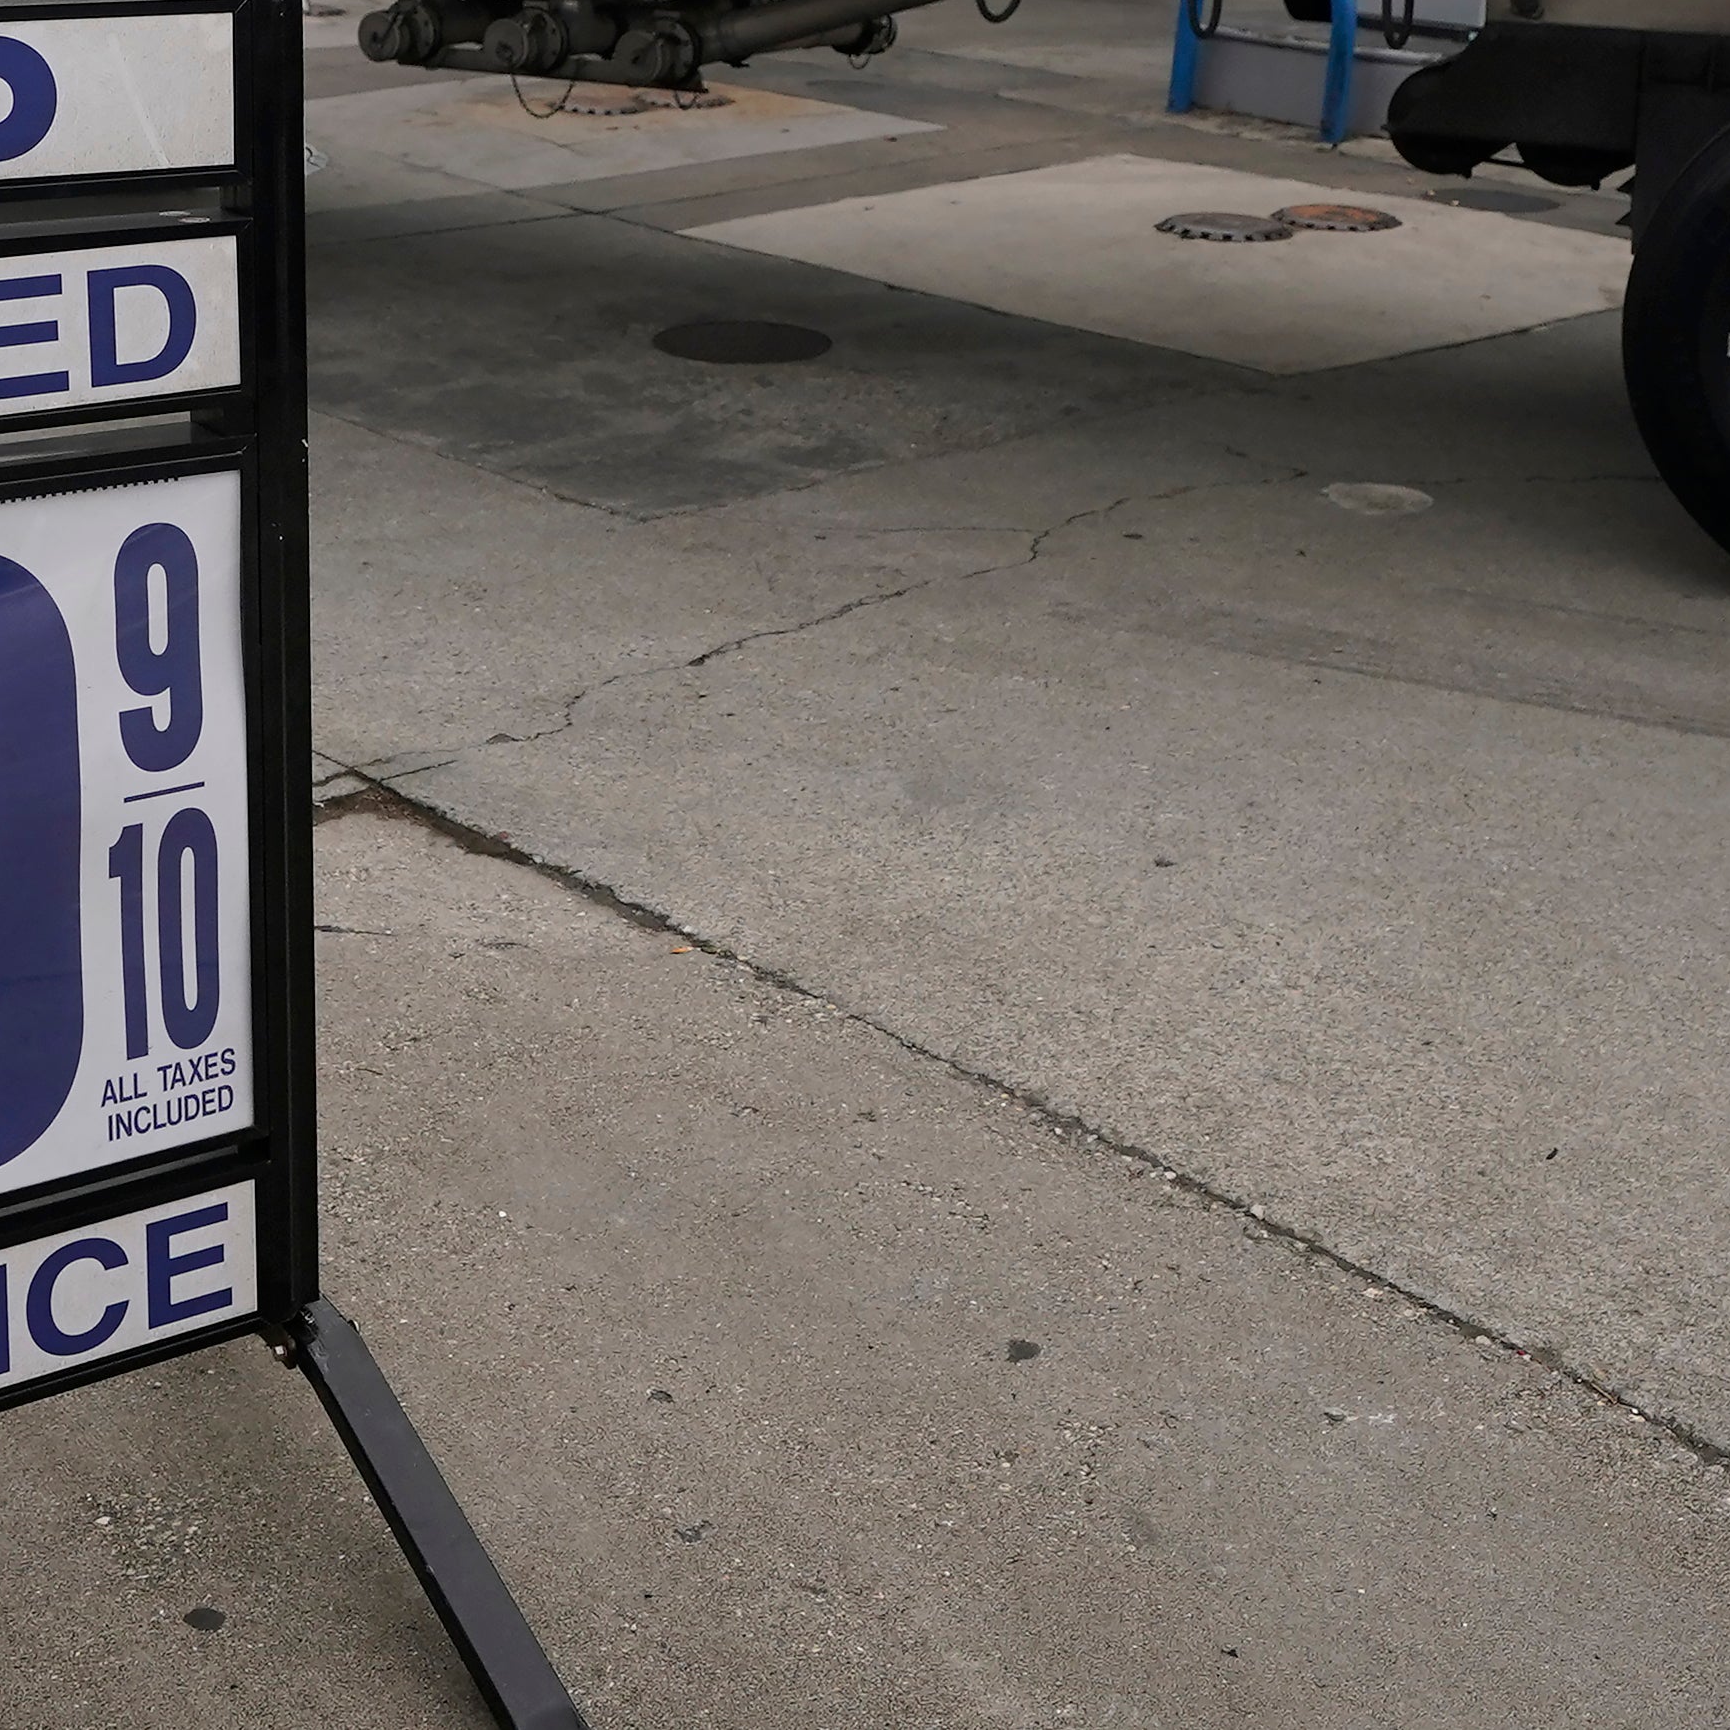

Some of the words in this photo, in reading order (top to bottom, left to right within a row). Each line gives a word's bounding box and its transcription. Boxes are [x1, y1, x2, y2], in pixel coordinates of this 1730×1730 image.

[114, 522, 204, 772] 9
[109, 807, 220, 1061] 10
[101, 1071, 148, 1108] ALL
[157, 1048, 237, 1092] TAXES
[107, 1085, 235, 1142] INCLUDED
